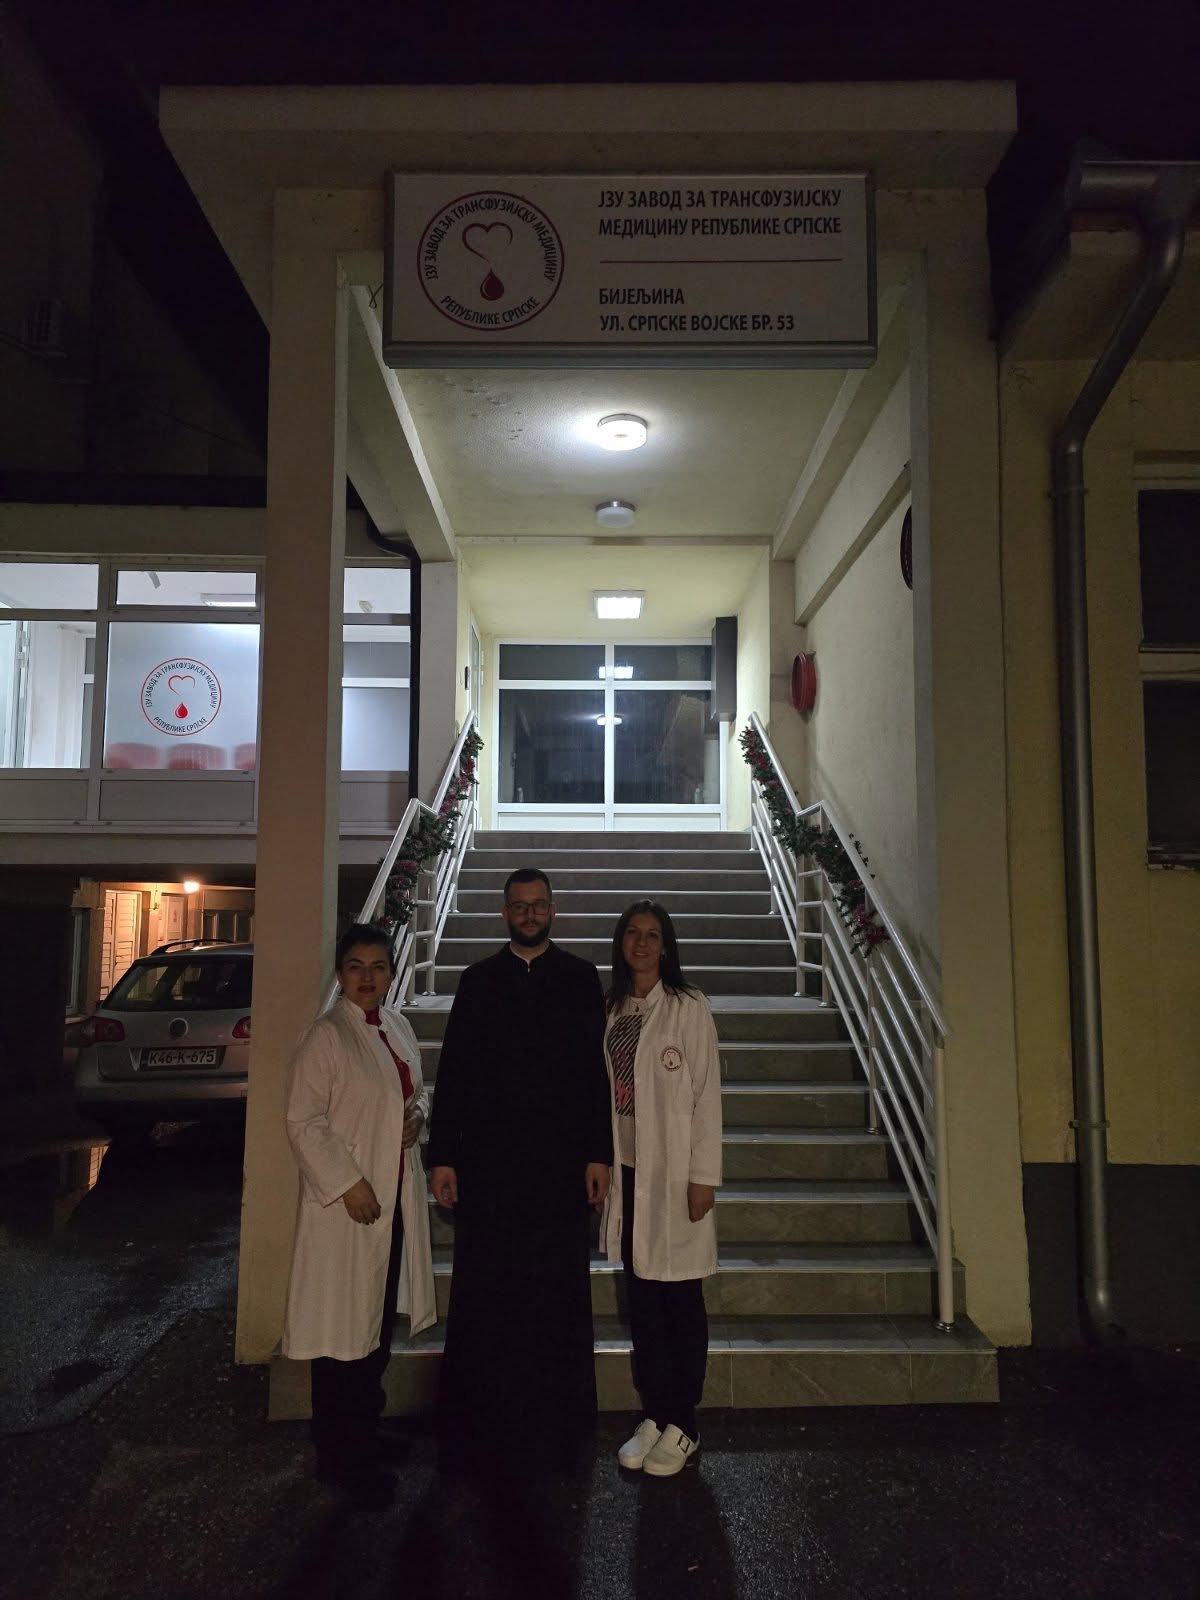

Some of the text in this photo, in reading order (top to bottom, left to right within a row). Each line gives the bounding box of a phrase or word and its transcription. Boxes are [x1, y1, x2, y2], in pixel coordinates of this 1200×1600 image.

[598, 189, 842, 210] ЈЗУ ЗАВОД ЗА ТРАНСФУЗИЈСКУ
[599, 217, 842, 238] МЕДИЦИНУ РЕПУБЛИКЕ СРПСКЕ
[425, 227, 447, 262] ЗАВОД
[439, 215, 455, 230] ЗА
[451, 198, 536, 224] ТРАНСФУЗИЈСКУ
[533, 221, 558, 282] МЕДИЦИНУ
[599, 288, 684, 304] БИЈЕЉИНА
[441, 295, 541, 325] РЕПУБЛИКЕ СРПСКЕ
[600, 314, 794, 331] УЛ. СРПСКЕ ВОЈСКЕ БР. 53
[149, 1050, 214, 1065] K46-K-675
